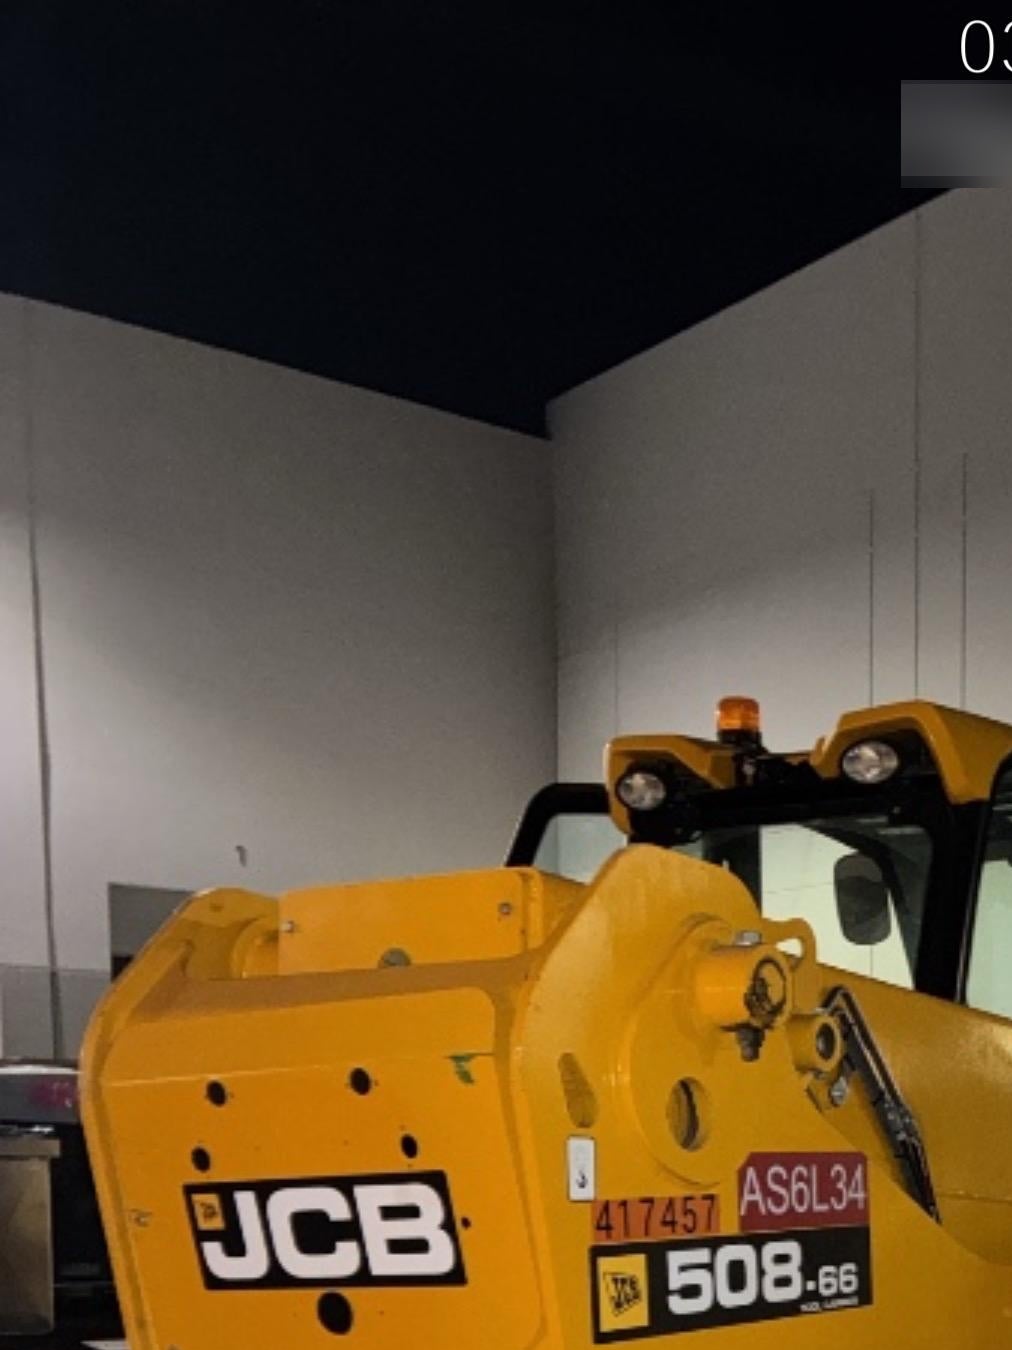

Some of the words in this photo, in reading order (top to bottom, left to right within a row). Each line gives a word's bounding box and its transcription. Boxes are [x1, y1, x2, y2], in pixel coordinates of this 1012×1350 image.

[740, 1163, 867, 1217] AS6L34
[201, 1182, 456, 1280] JCB
[594, 1195, 716, 1240] 417457
